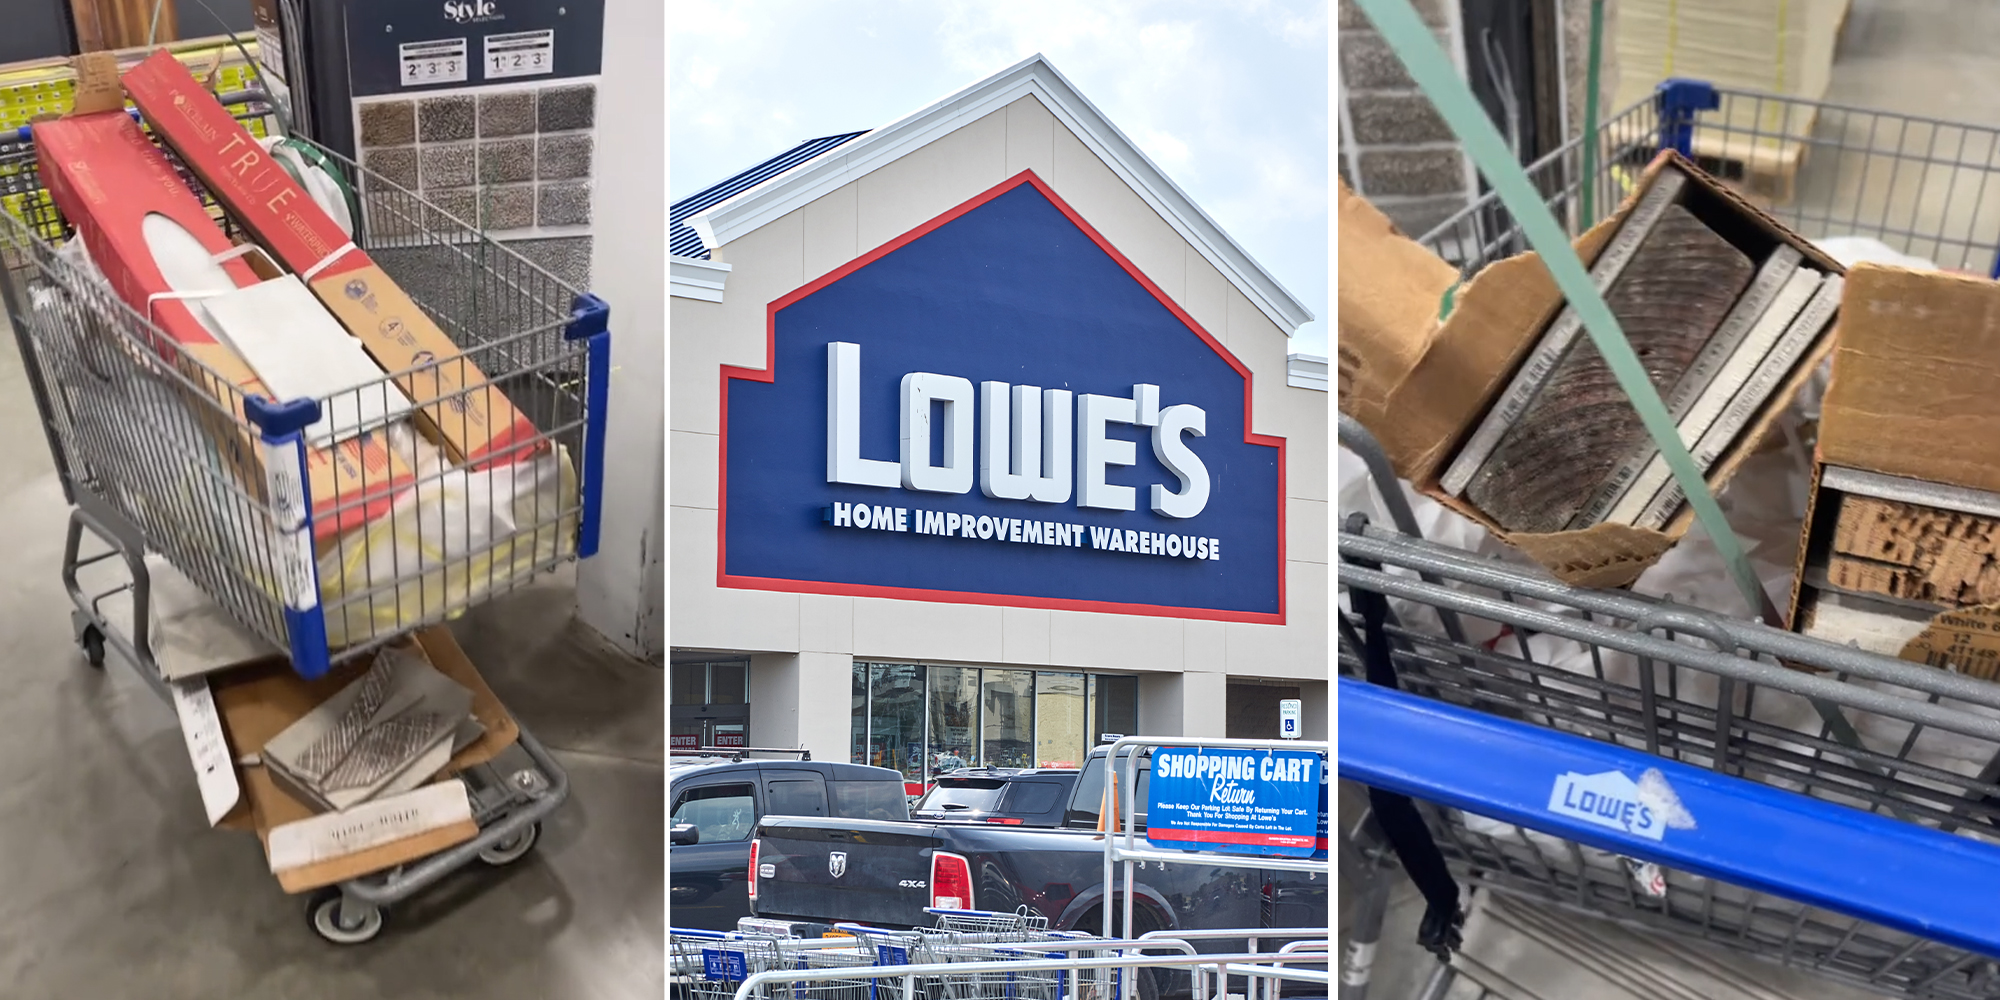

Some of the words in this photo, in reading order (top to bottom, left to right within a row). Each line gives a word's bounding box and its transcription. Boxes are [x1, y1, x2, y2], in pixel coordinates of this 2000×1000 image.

[444, 0, 495, 24] Style
[218, 132, 297, 214] TRUE
[827, 341, 1210, 518] LOWE'S
[834, 501, 908, 532] HOME
[915, 509, 1085, 547] IMPROVEMENT
[1089, 525, 1220, 560] WAREHOUSE
[1940, 614, 1986, 629] White
[670, 736, 697, 746] ENTER
[717, 735, 743, 745] ENTER
[1157, 753, 1255, 781] SHOPPING
[1260, 756, 1314, 783] CART
[1209, 773, 1255, 805] Return
[1202, 804, 1220, 812] Parking
[1246, 806, 1253, 814] By
[1255, 807, 1280, 815] Returning
[1225, 813, 1249, 821] Shopping
[1563, 782, 1653, 829] LOWE'S
